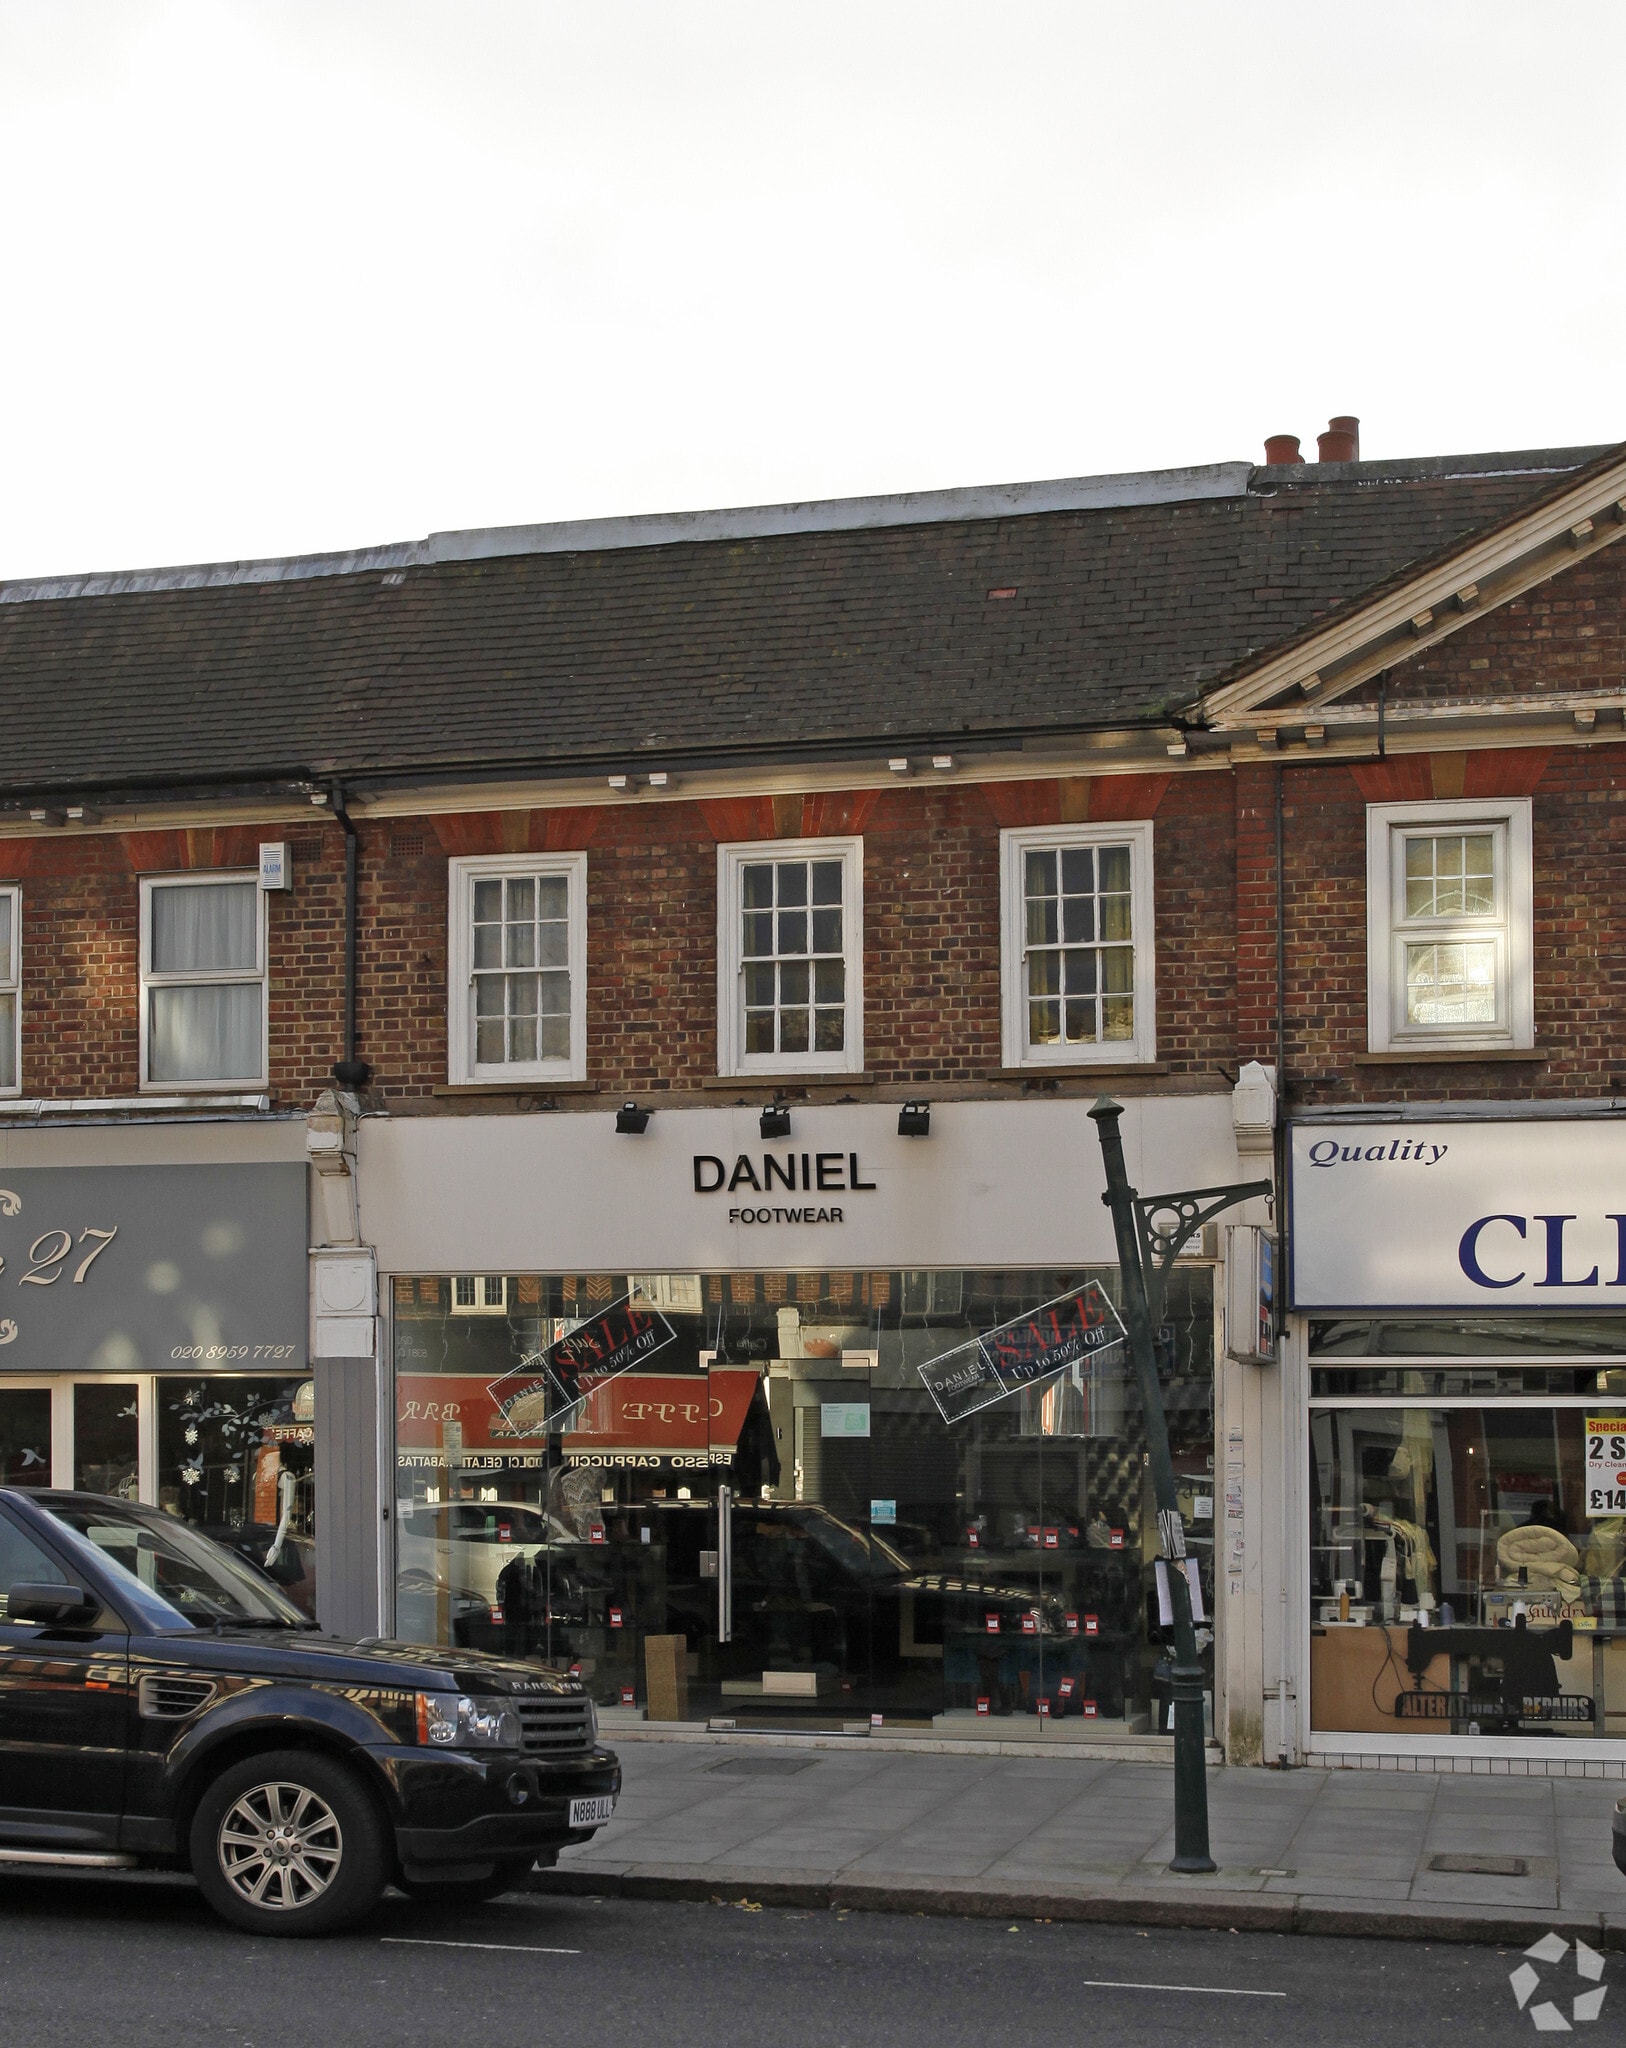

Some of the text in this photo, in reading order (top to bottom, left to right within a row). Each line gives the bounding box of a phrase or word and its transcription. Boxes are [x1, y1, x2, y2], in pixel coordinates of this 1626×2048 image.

[1308, 1138, 1448, 1168] Quality
[693, 1153, 877, 1192] DANIEL
[729, 1207, 843, 1223] FOOTWEAR
[19, 1226, 118, 1286] 27
[554, 1304, 653, 1379] SALE
[995, 1289, 1105, 1370] SALE
[170, 1344, 296, 1359] 020 8959 7727
[573, 1329, 655, 1389] Up to 50% Off
[1011, 1363, 1034, 1379] Up
[1036, 1357, 1051, 1369] to
[1053, 1339, 1080, 1361] 50%
[1084, 1325, 1105, 1346] Off
[934, 1362, 986, 1391] DANIEL
[504, 1376, 549, 1409] DANIEL
[1589, 1436, 1604, 1460] 2
[1588, 1461, 1602, 1469] Dry
[1522, 1696, 1590, 1720] REPAIRS
[573, 1799, 610, 1823] N888 ULL
